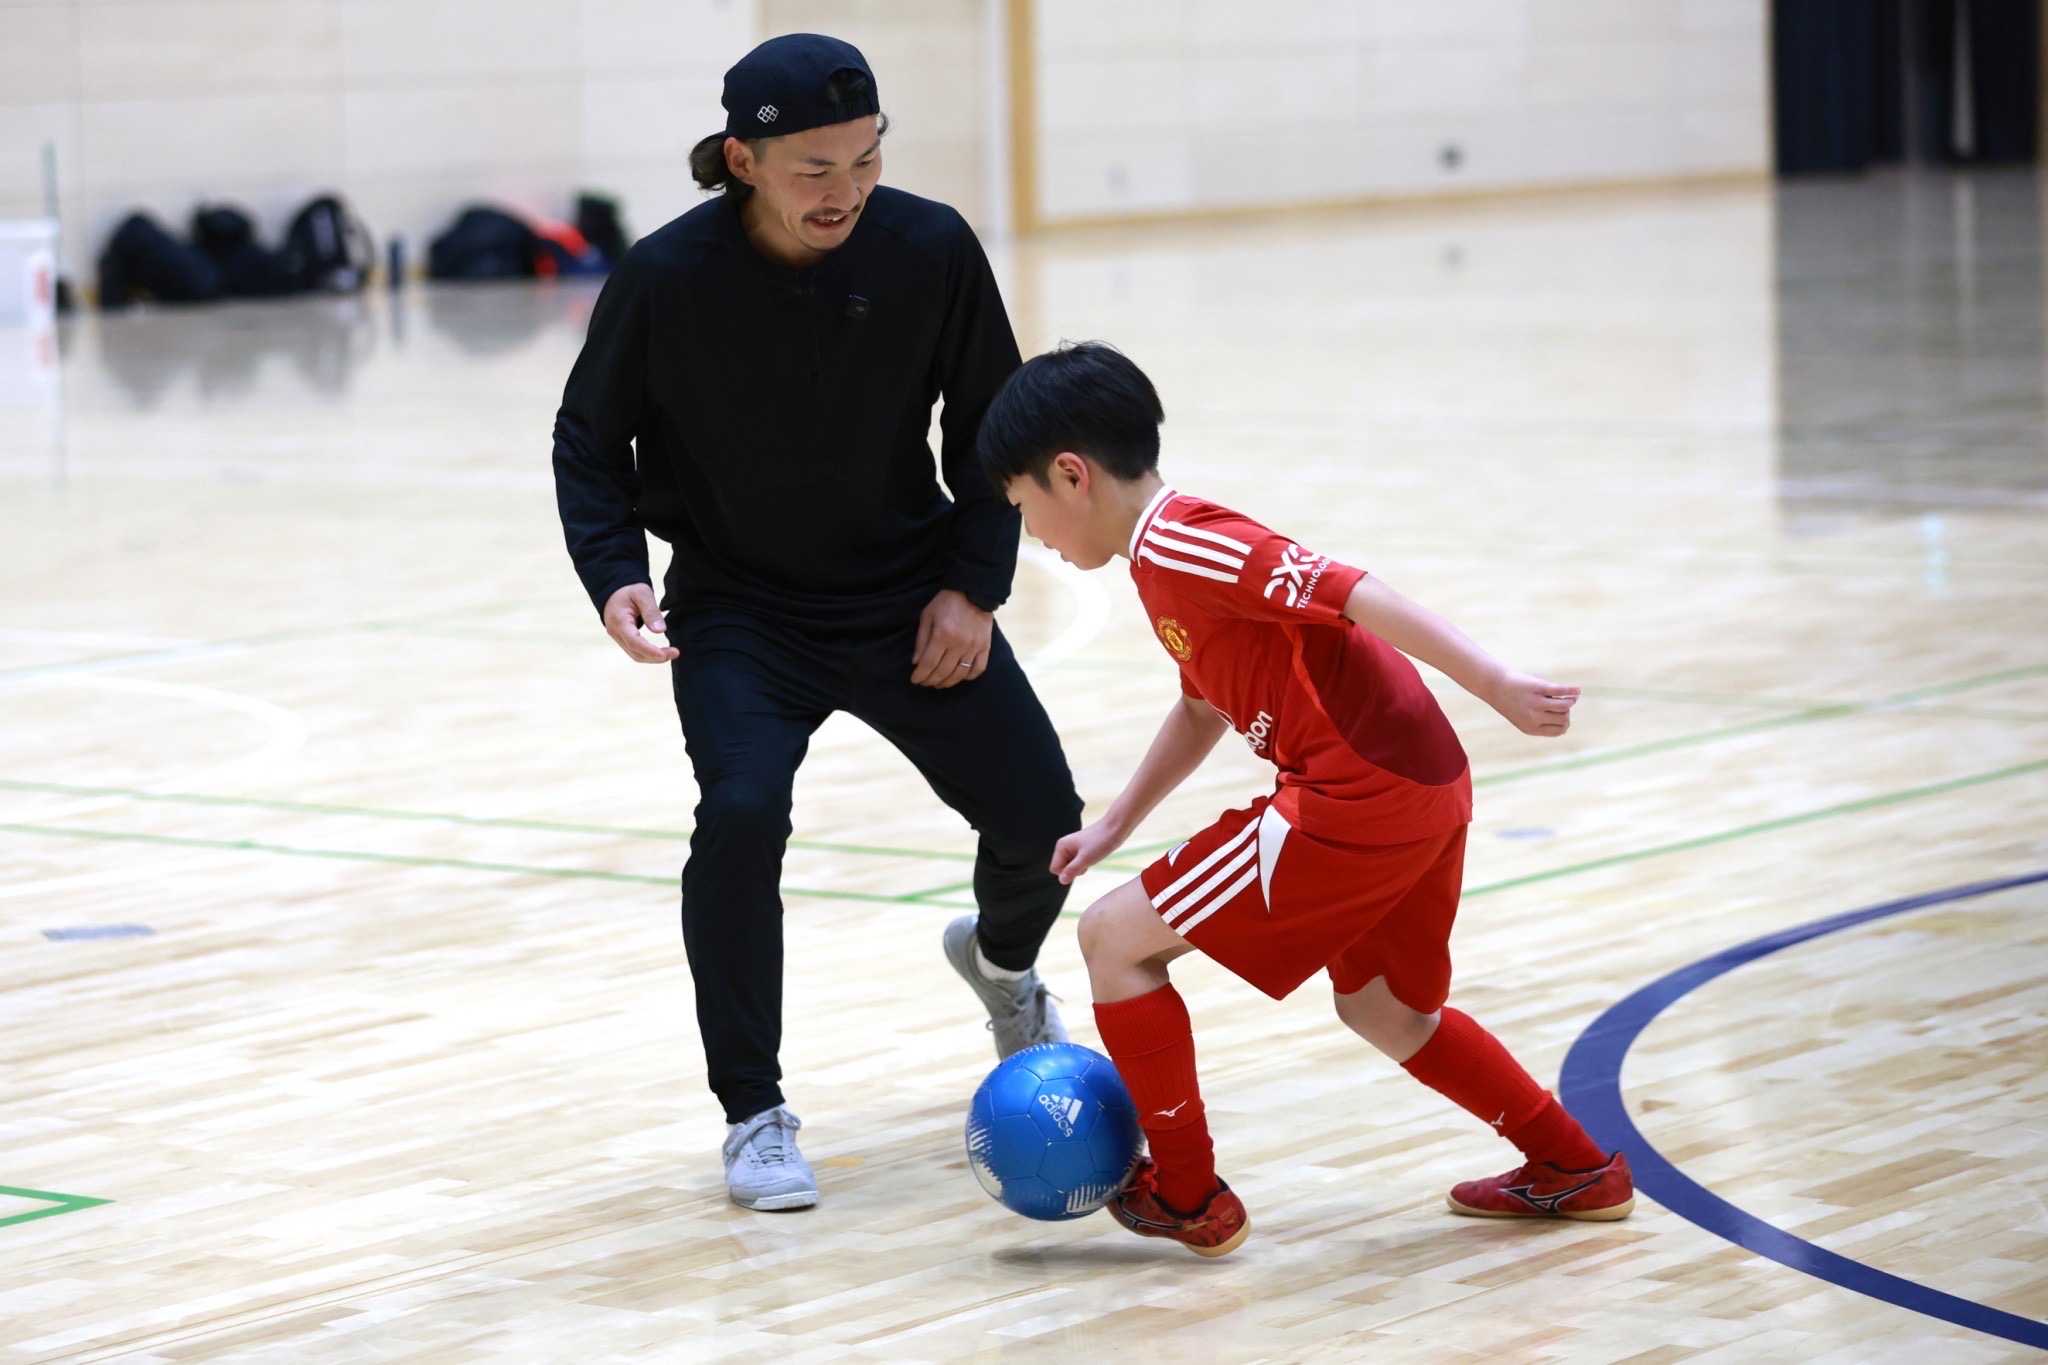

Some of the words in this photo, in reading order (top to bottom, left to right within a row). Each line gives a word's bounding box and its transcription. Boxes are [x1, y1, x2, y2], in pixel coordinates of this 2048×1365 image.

[1263, 543, 1322, 608] DXC
[1296, 558, 1332, 609] TECHNOLOG
[1244, 710, 1273, 752] gon
[1038, 1094, 1074, 1138] adidas
